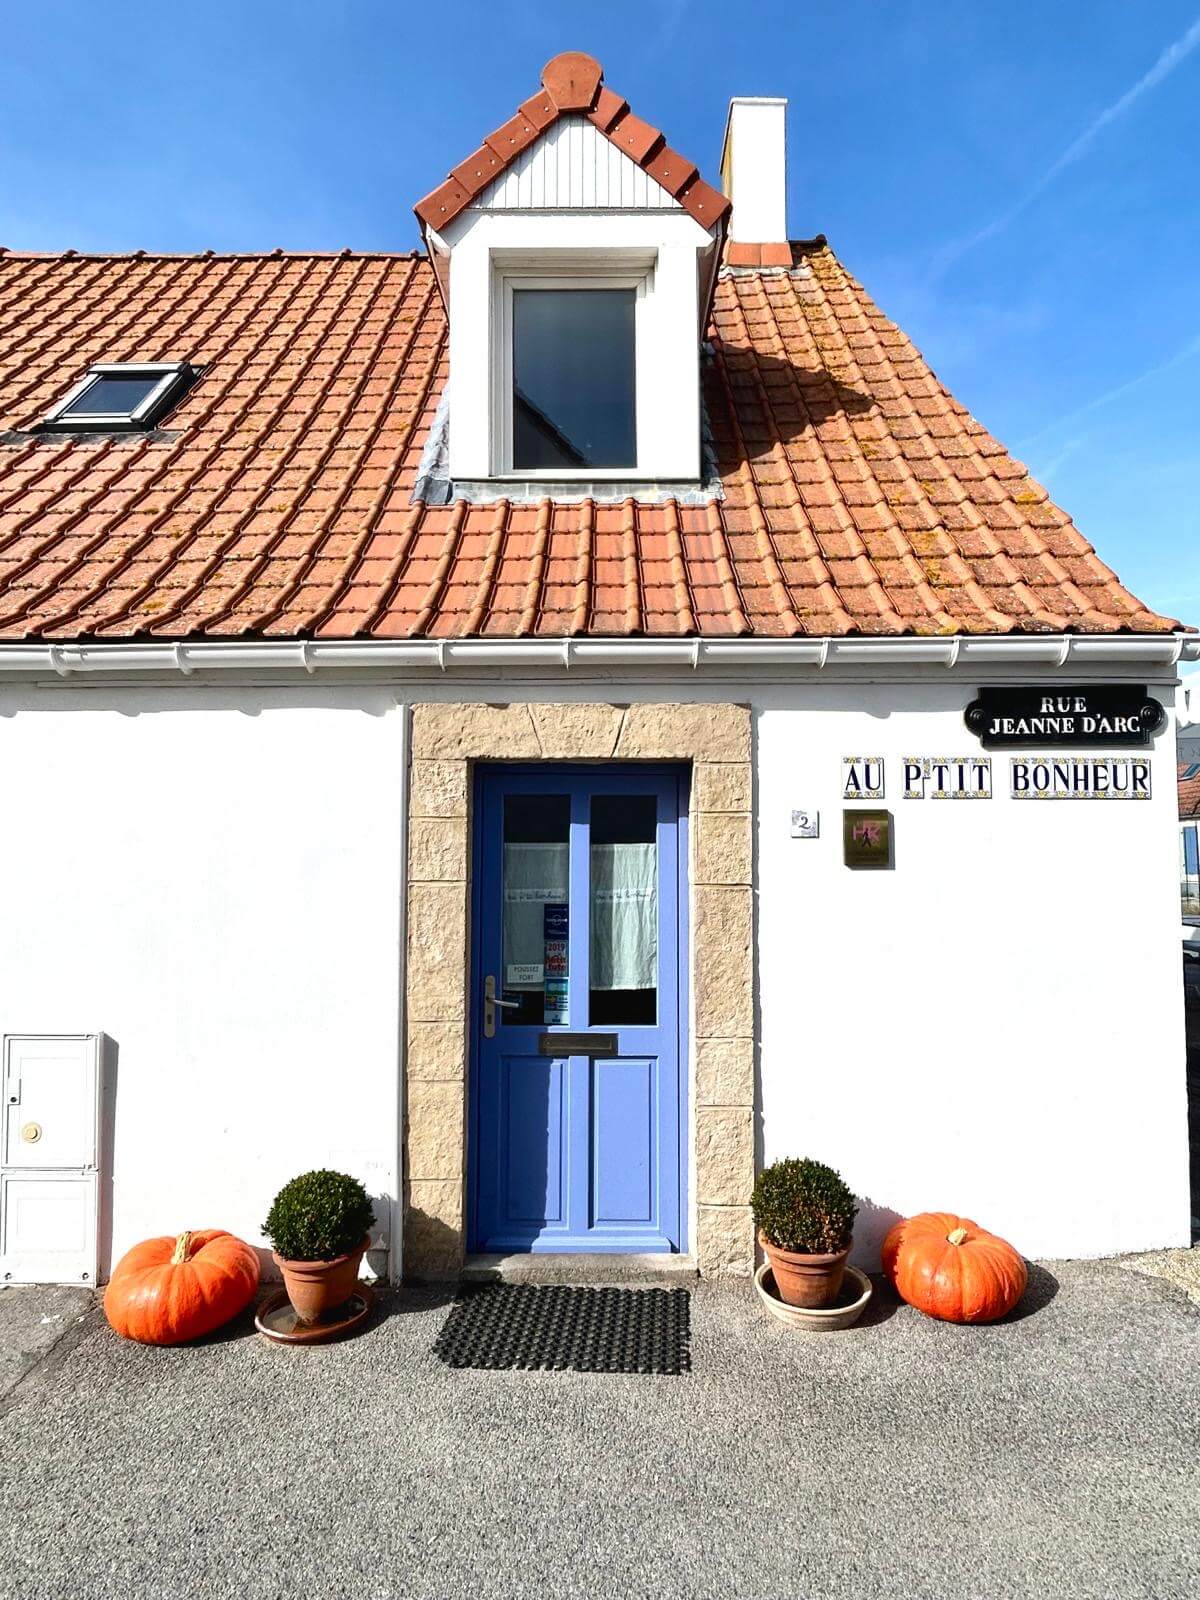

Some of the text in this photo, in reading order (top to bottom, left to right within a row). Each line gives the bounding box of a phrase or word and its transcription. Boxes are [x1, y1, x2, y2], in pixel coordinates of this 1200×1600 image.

[1039, 696, 1087, 713] RUE
[989, 713, 1141, 735] JEANNE D'ARC
[845, 764, 882, 791] AU
[1013, 764, 1149, 792] BONHEUR
[798, 815, 811, 830] 2
